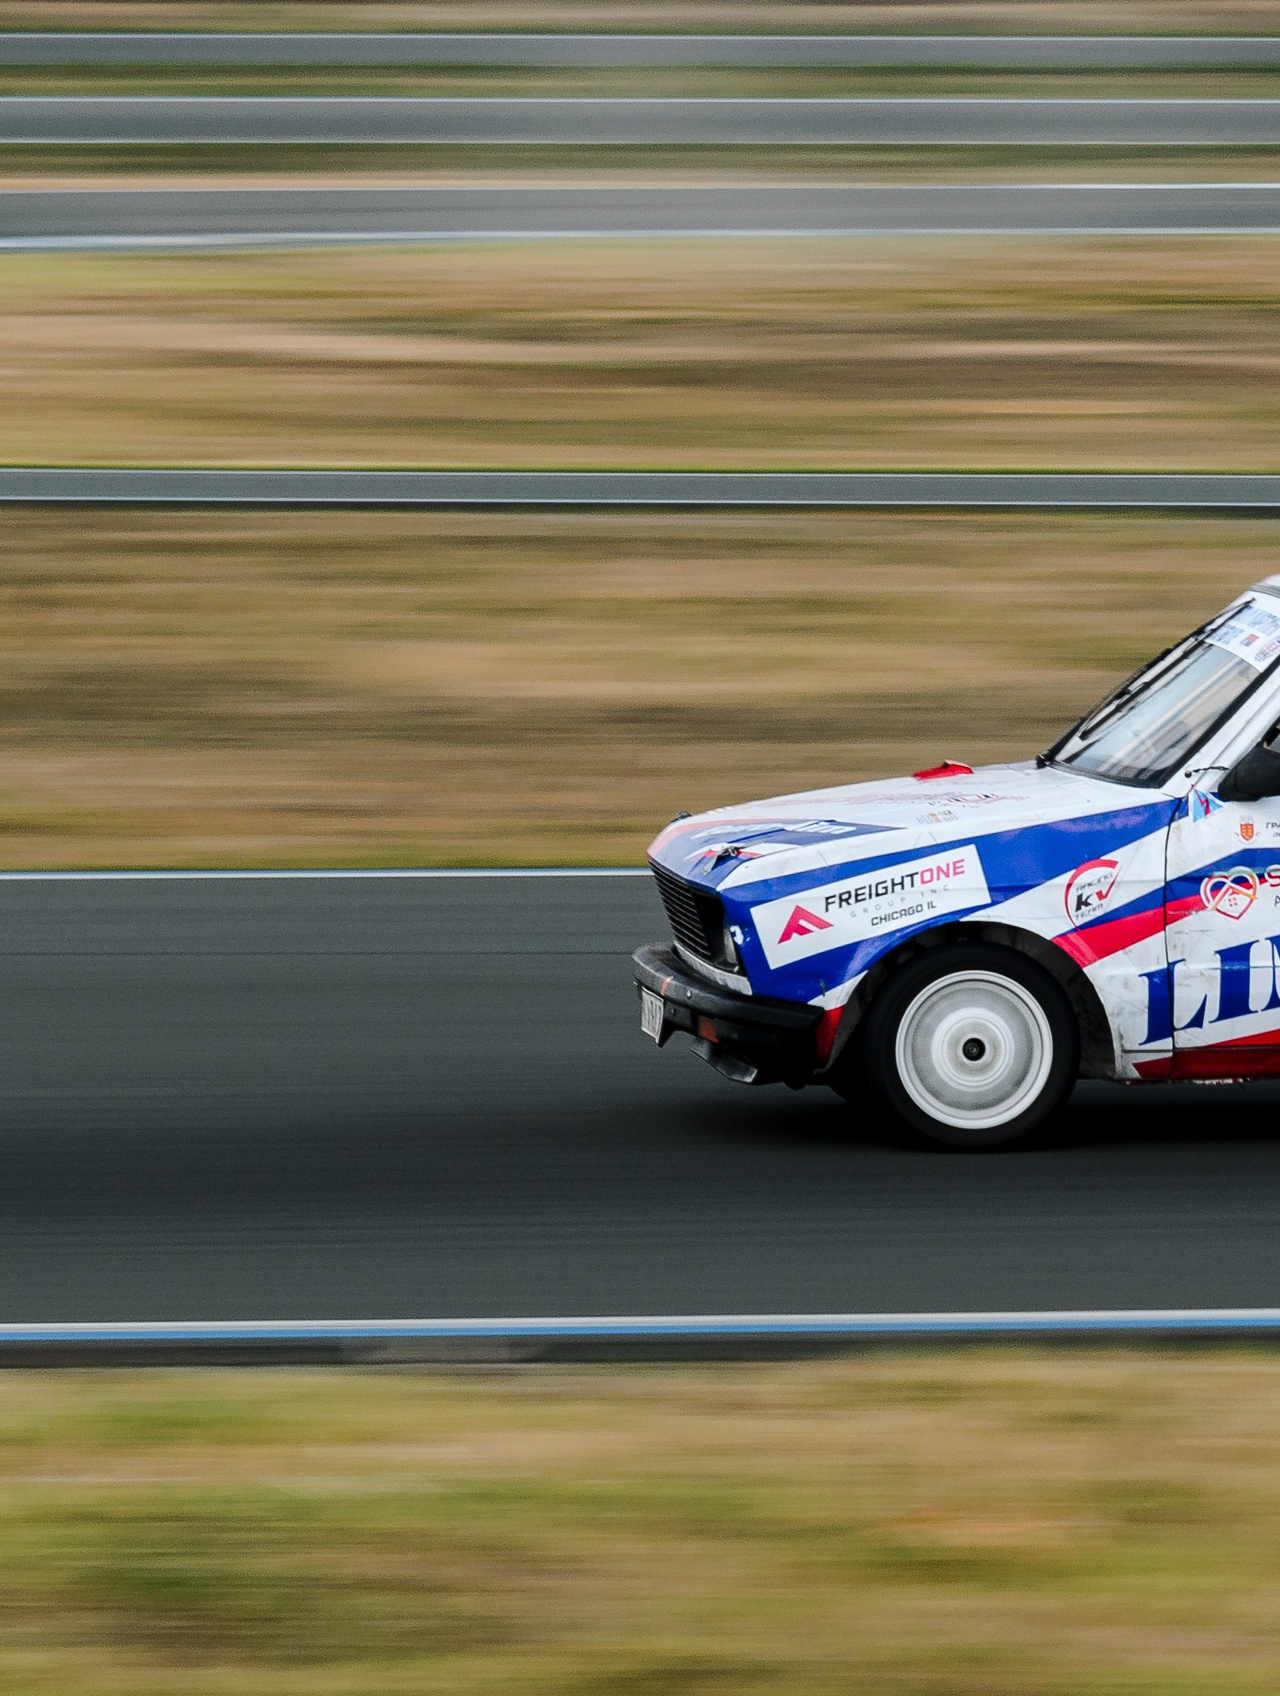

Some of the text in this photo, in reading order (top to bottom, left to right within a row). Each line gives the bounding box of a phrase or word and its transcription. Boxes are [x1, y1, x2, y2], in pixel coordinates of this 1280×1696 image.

[825, 858, 966, 913] FREIGHTONE
[850, 897, 906, 918] GROUP
[871, 900, 937, 926] CHICAGO IL
